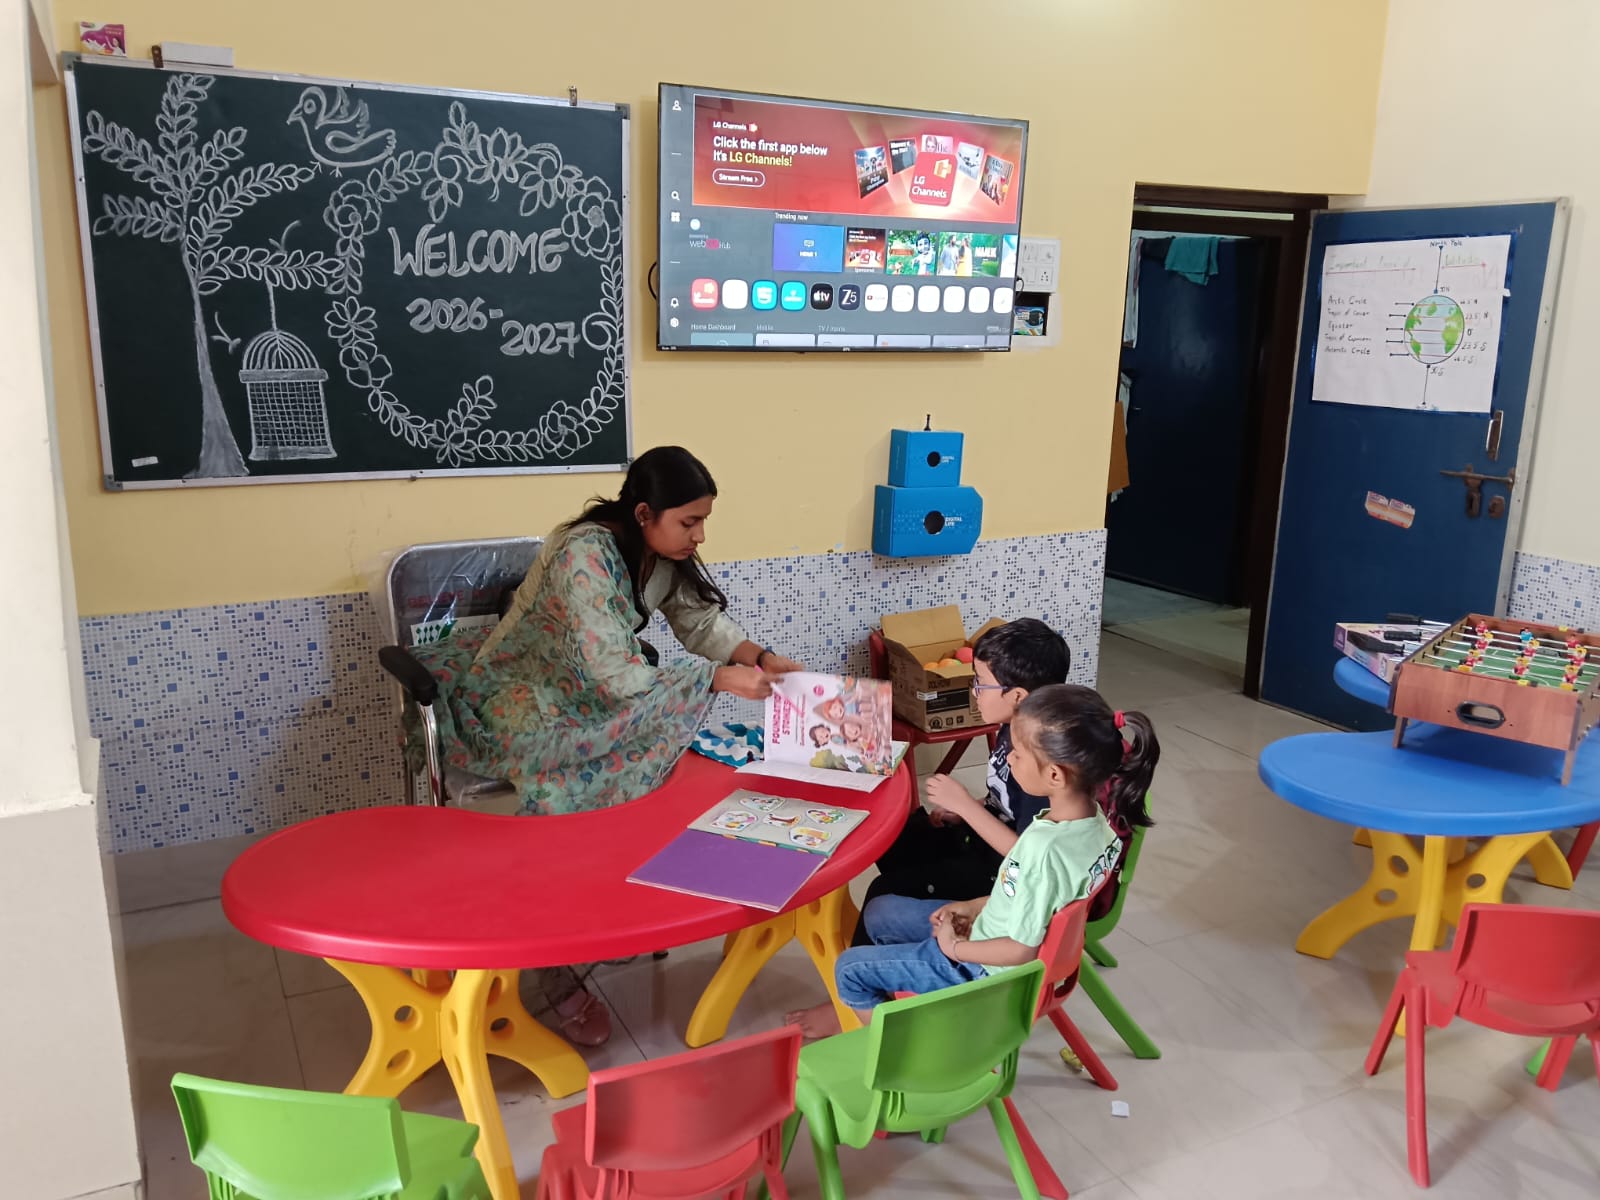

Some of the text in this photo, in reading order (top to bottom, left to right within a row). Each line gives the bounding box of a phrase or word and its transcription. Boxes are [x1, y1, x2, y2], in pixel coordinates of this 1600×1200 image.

[713, 135, 828, 156] Click the first app below
[713, 150, 792, 166] It's LG Channels!
[911, 176, 948, 199] LG Channels
[775, 212, 796, 221] Trending
[388, 223, 570, 277] WELCOME
[500, 320, 581, 358] 2027
